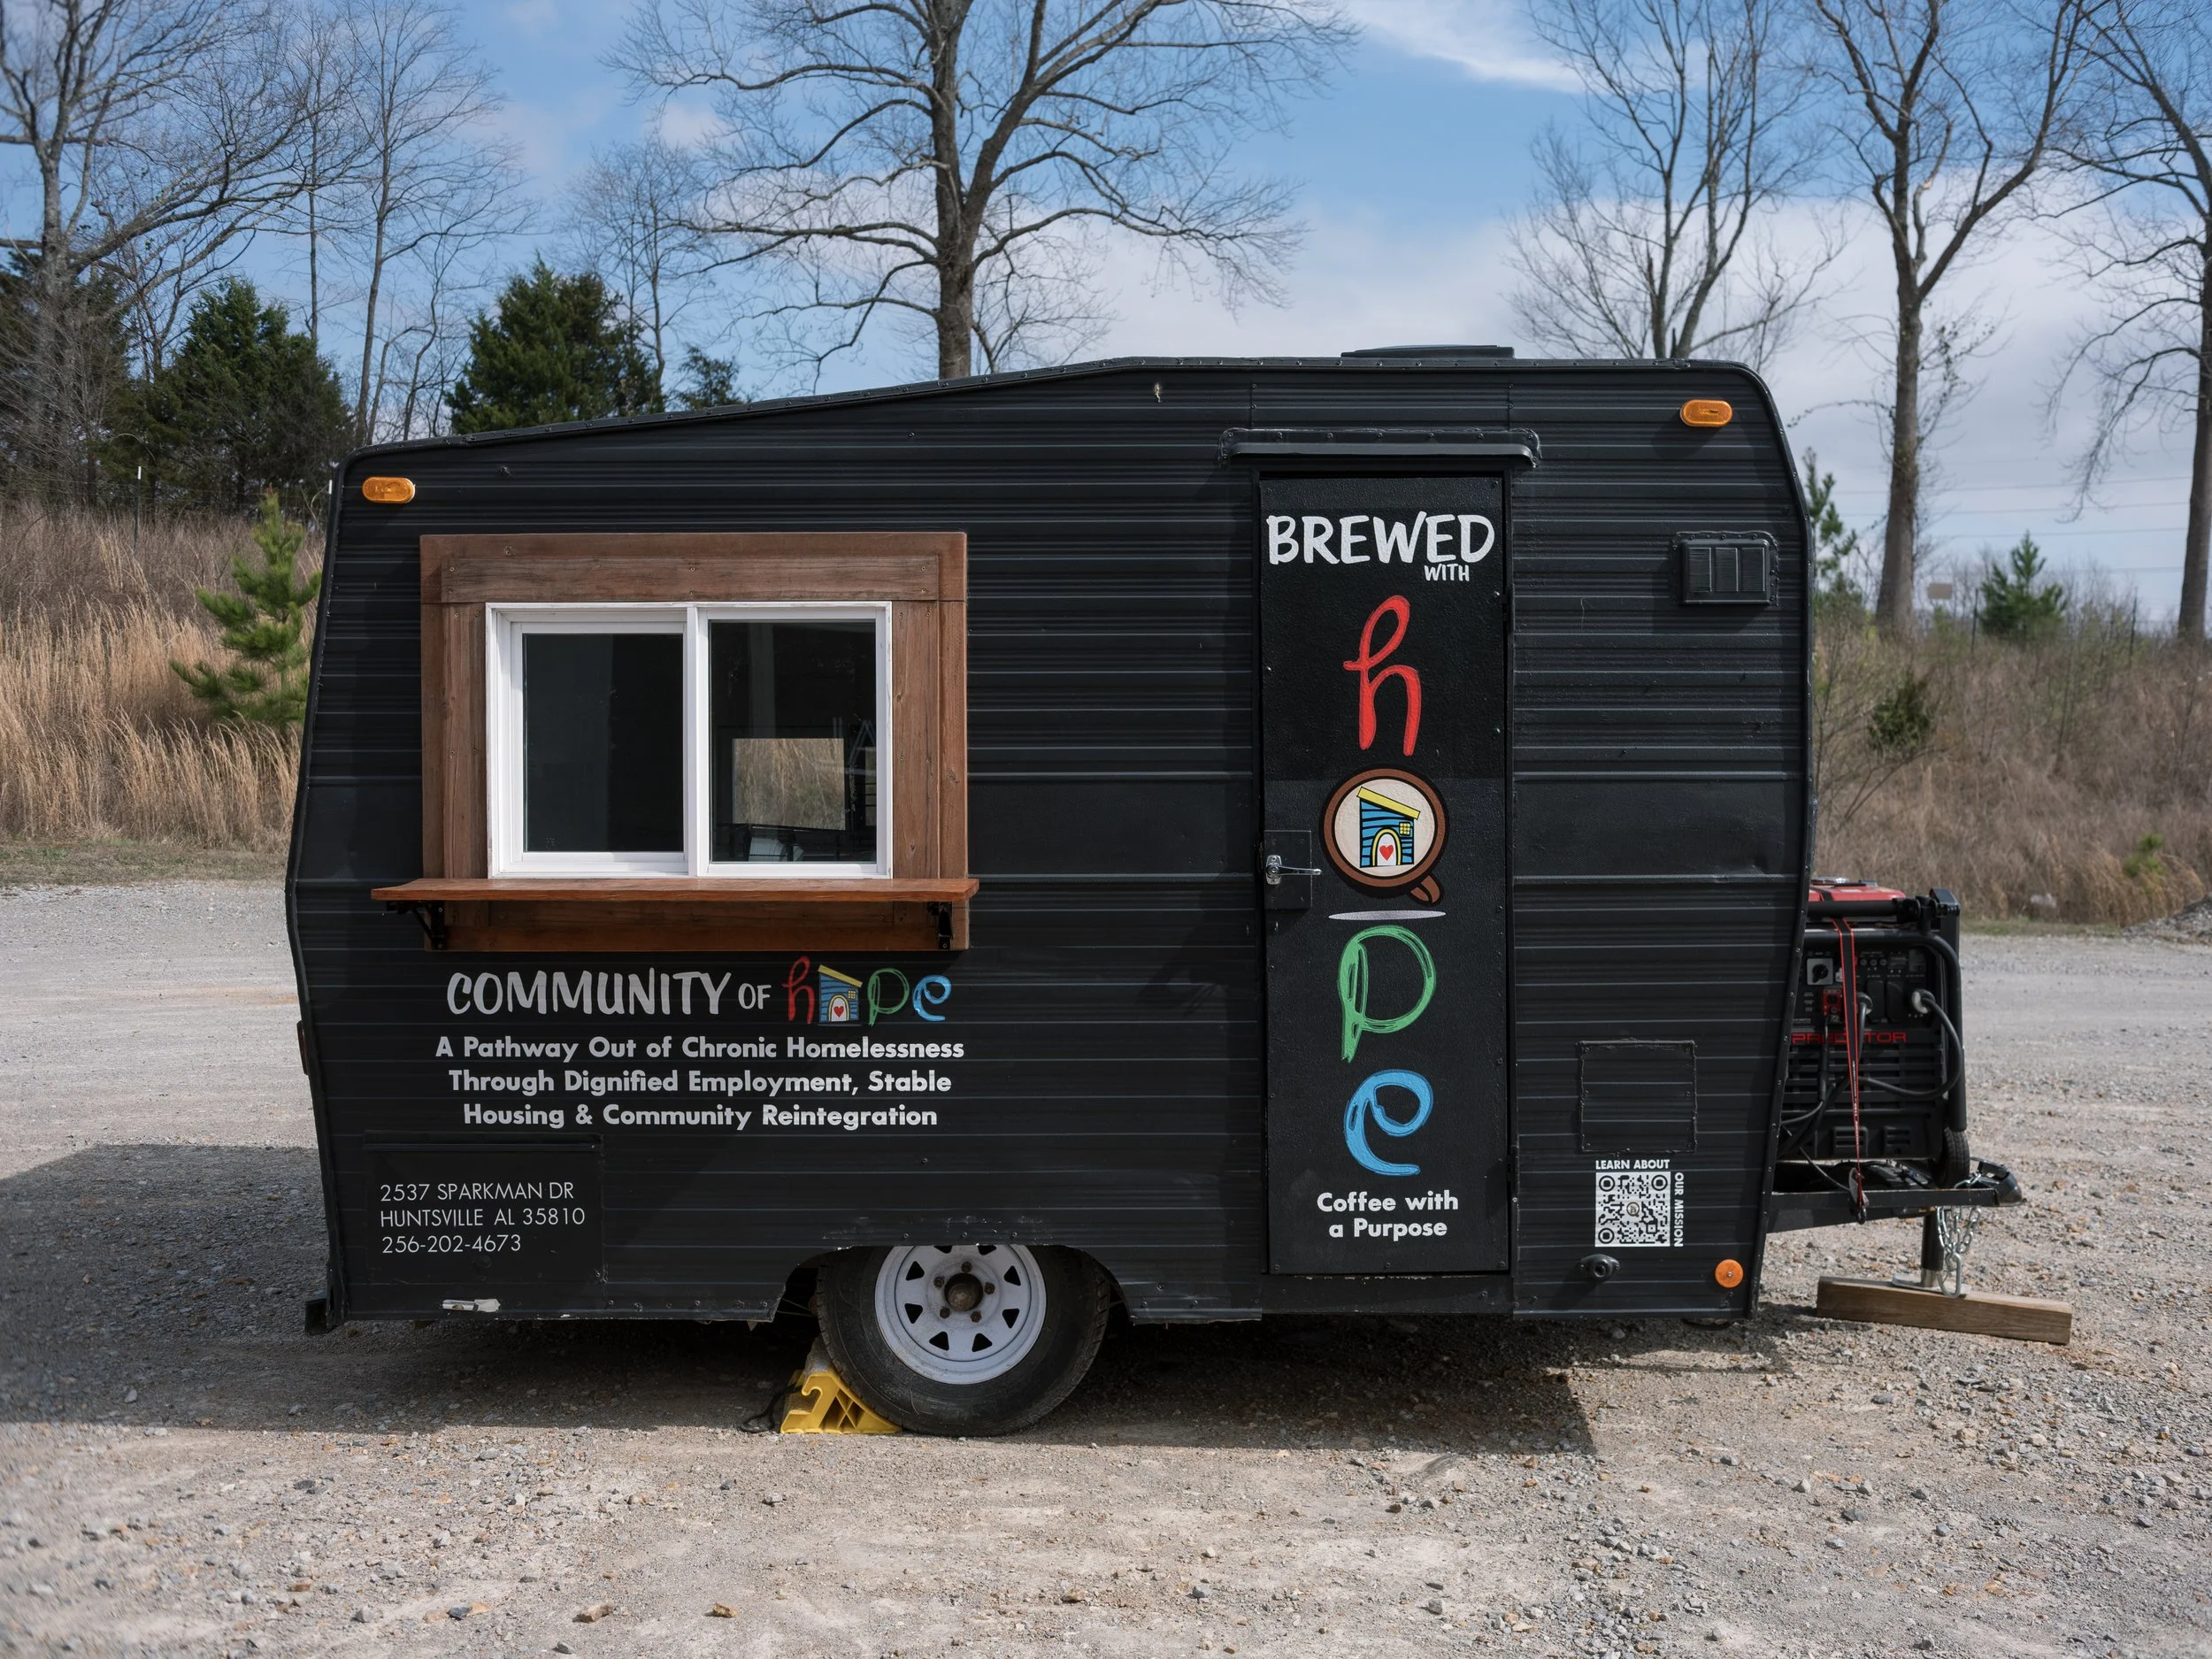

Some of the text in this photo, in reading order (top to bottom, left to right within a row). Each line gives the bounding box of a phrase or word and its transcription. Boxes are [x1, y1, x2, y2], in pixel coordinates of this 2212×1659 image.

[1266, 511, 1495, 565] BREWED
[1424, 563, 1470, 581] WITH
[447, 968, 732, 1015] COMMUNITY
[738, 983, 772, 1010] OF
[435, 1035, 964, 1063] A Pathway Out of Chronic Homelessness
[449, 1069, 952, 1097] Through Dignified Employment, Stable
[464, 1103, 938, 1131] Housing & Community Reintegration
[1595, 1159, 1670, 1170] LEARN ABOUT
[380, 1182, 574, 1202] 2537 SPARKMAN DR
[1317, 1189, 1459, 1212] Coffee with
[380, 1208, 586, 1228] HUNTSVILLE AL 35810
[1674, 1172, 1684, 1247] OUR MISSION
[1328, 1217, 1448, 1241] a Purpose
[381, 1234, 521, 1254] 256-202-4673
